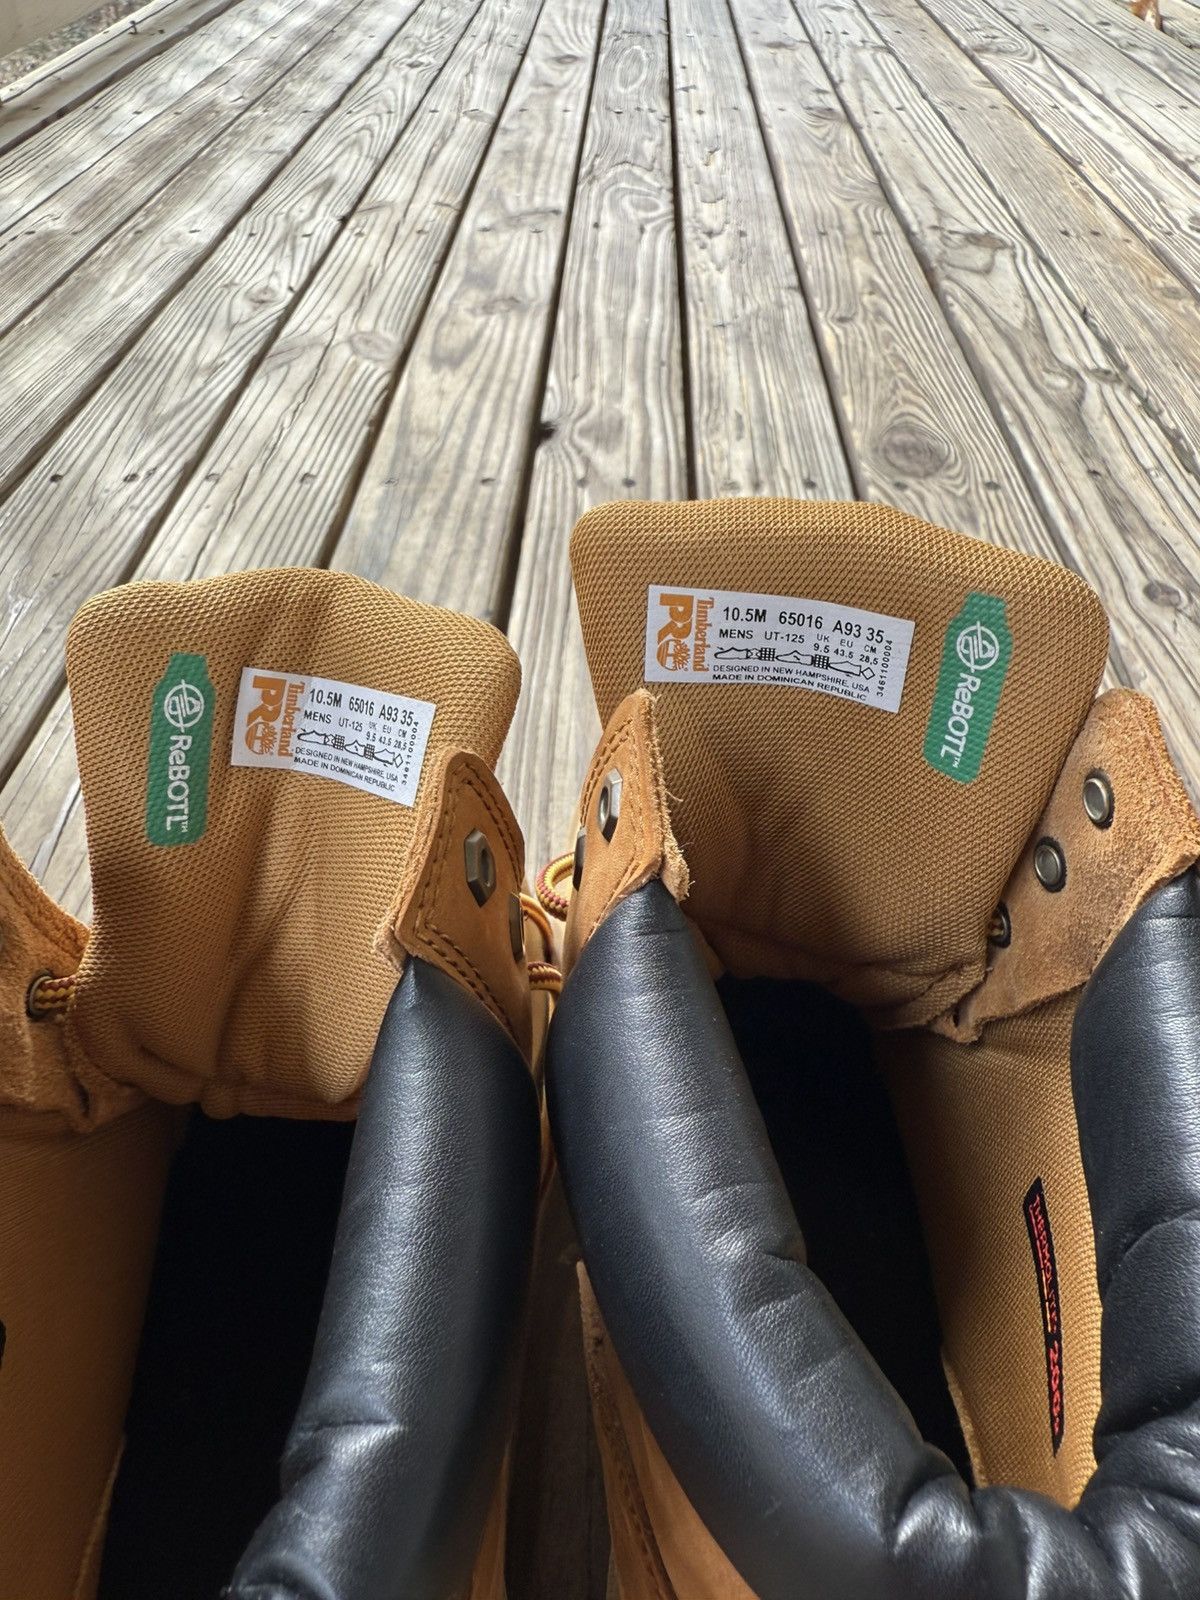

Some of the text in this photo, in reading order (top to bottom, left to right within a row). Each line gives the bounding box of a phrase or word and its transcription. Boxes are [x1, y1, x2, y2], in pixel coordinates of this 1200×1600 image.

[692, 597, 714, 672] Timberland
[719, 628, 805, 644] MENS UT-125
[723, 606, 884, 643] 10.5M 65016 A93 35
[813, 642, 830, 654] 9.5
[833, 648, 854, 659] 43.5
[816, 633, 877, 654] UK EU CM
[713, 664, 759, 673] DESIGNED
[773, 667, 793, 675] NEW
[852, 681, 870, 693] USA
[757, 674, 814, 687] DOMINICAN
[817, 682, 867, 701] REPUBLIC
[278, 681, 305, 757] Timberland
[303, 710, 363, 732] MENS UT-125
[309, 688, 414, 726] 10.5M 65016 A93 35
[383, 724, 392, 734] EU
[294, 756, 395, 792] MADE IN DOMINICAN REPUBLIC
[295, 747, 333, 760] DESIGNED
[334, 755, 340, 763] IN
[341, 757, 353, 767] NEW
[386, 772, 399, 782] USA
